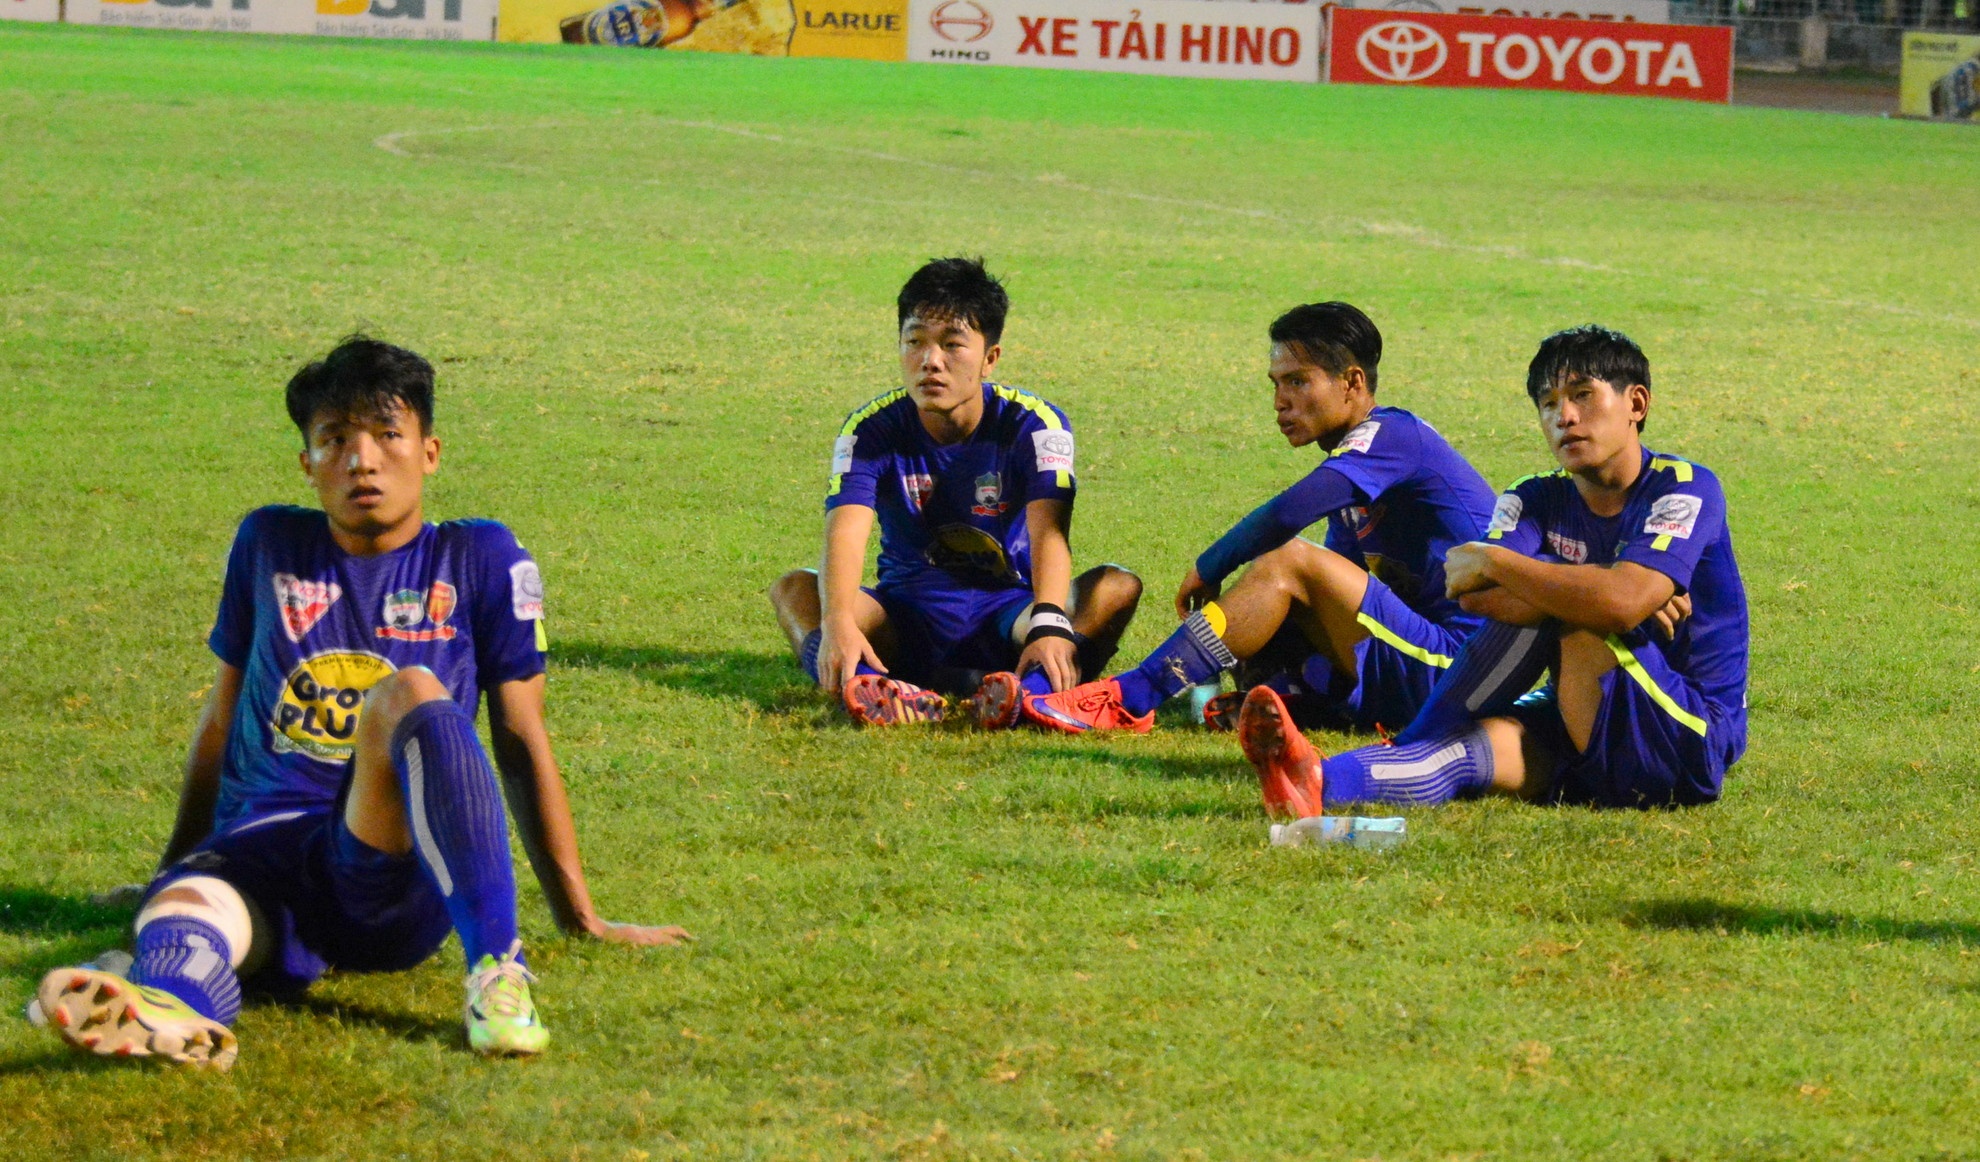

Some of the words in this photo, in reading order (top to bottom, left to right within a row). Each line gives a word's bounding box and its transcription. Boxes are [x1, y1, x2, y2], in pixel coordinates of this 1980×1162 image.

[805, 10, 900, 31] LARUE
[1016, 15, 1078, 57] XE
[1091, 9, 1166, 61] TẢI
[1180, 24, 1299, 67] HINO
[931, 49, 991, 61] HINO
[1456, 31, 1703, 88] TOYOTA
[293, 671, 370, 710] Gro
